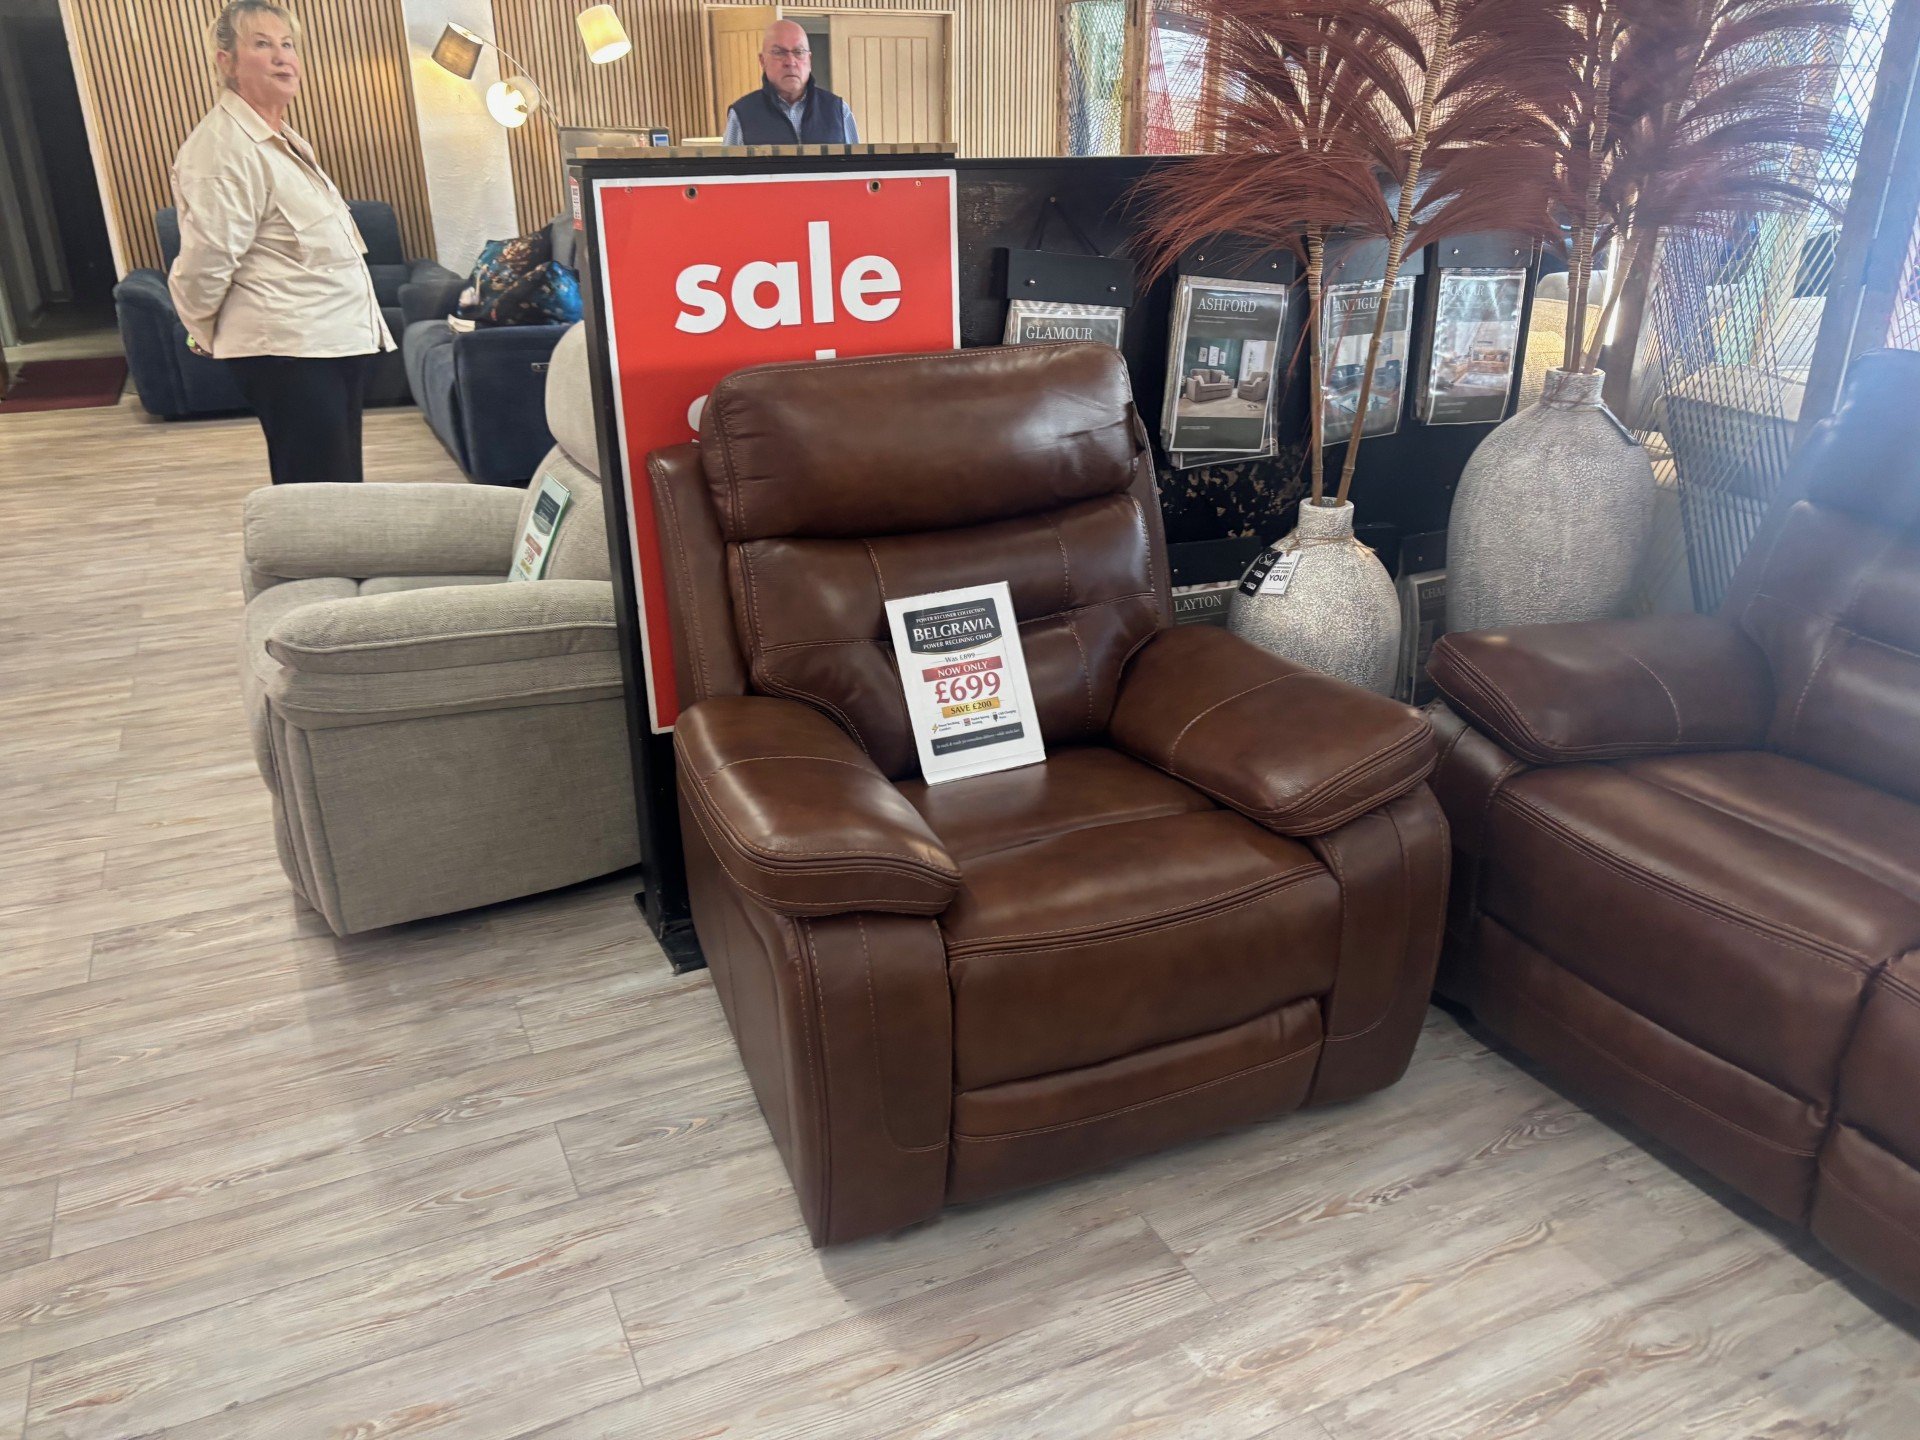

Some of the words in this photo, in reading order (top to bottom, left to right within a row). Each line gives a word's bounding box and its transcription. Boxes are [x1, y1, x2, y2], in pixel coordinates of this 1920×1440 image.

[675, 220, 902, 333] sale
[1197, 297, 1257, 313] ASHFORD
[1026, 325, 1093, 340] GLAMOUR
[1269, 574, 1288, 582] YOU!
[957, 607, 986, 617] COLLECTION
[912, 617, 995, 642] BELGRAVIA
[923, 641, 945, 650] POWER
[944, 636, 975, 646] RECLINING
[975, 632, 993, 641] CHAIR
[959, 652, 976, 661] £899
[937, 668, 961, 678] NOW
[963, 661, 988, 672] ONLY
[935, 671, 1001, 704] £699
[950, 705, 971, 715] SAVE
[972, 700, 992, 710] £200
